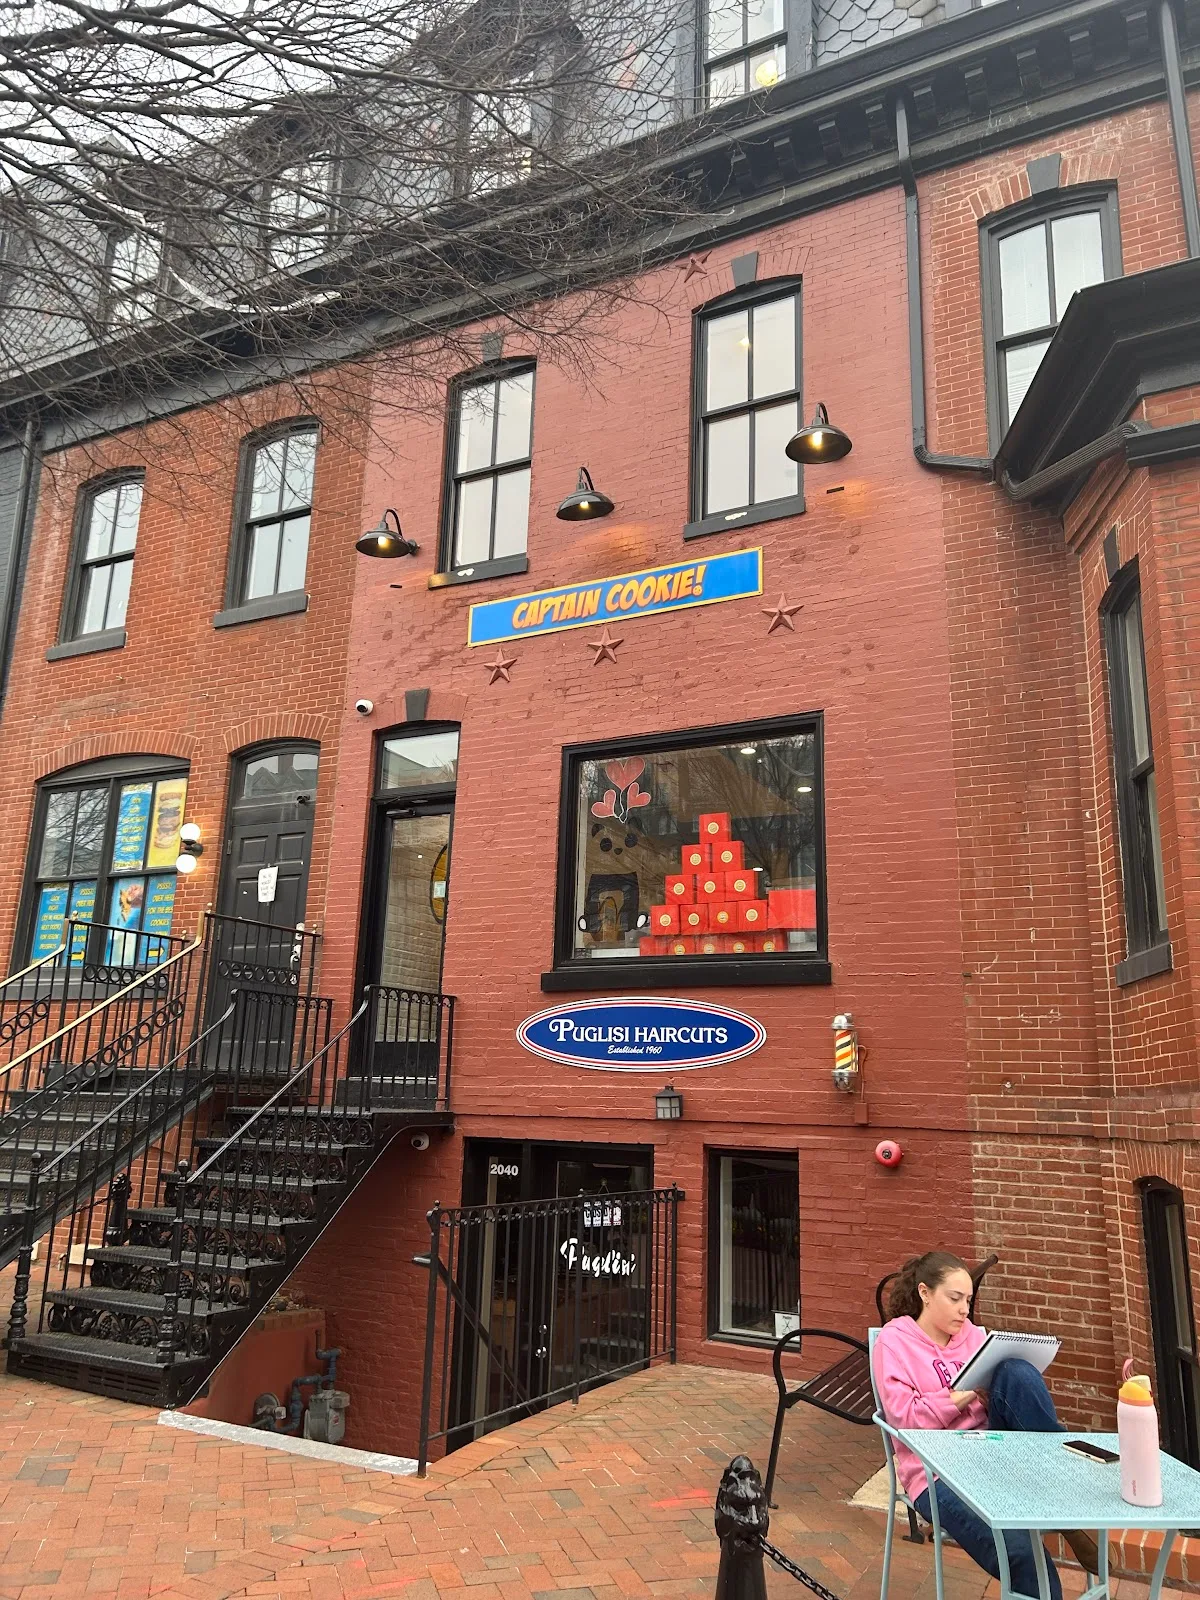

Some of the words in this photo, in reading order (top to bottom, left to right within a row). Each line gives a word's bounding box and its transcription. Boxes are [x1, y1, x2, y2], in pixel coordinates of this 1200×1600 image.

[512, 587, 602, 630] CAPTAIN
[604, 564, 707, 614] COOKIE!
[549, 1018, 630, 1043] PUGLISI
[634, 1026, 728, 1044] HAIRCUTS
[607, 1045, 644, 1054] Established
[645, 1045, 663, 1054] 1960
[490, 1163, 519, 1177] 2040
